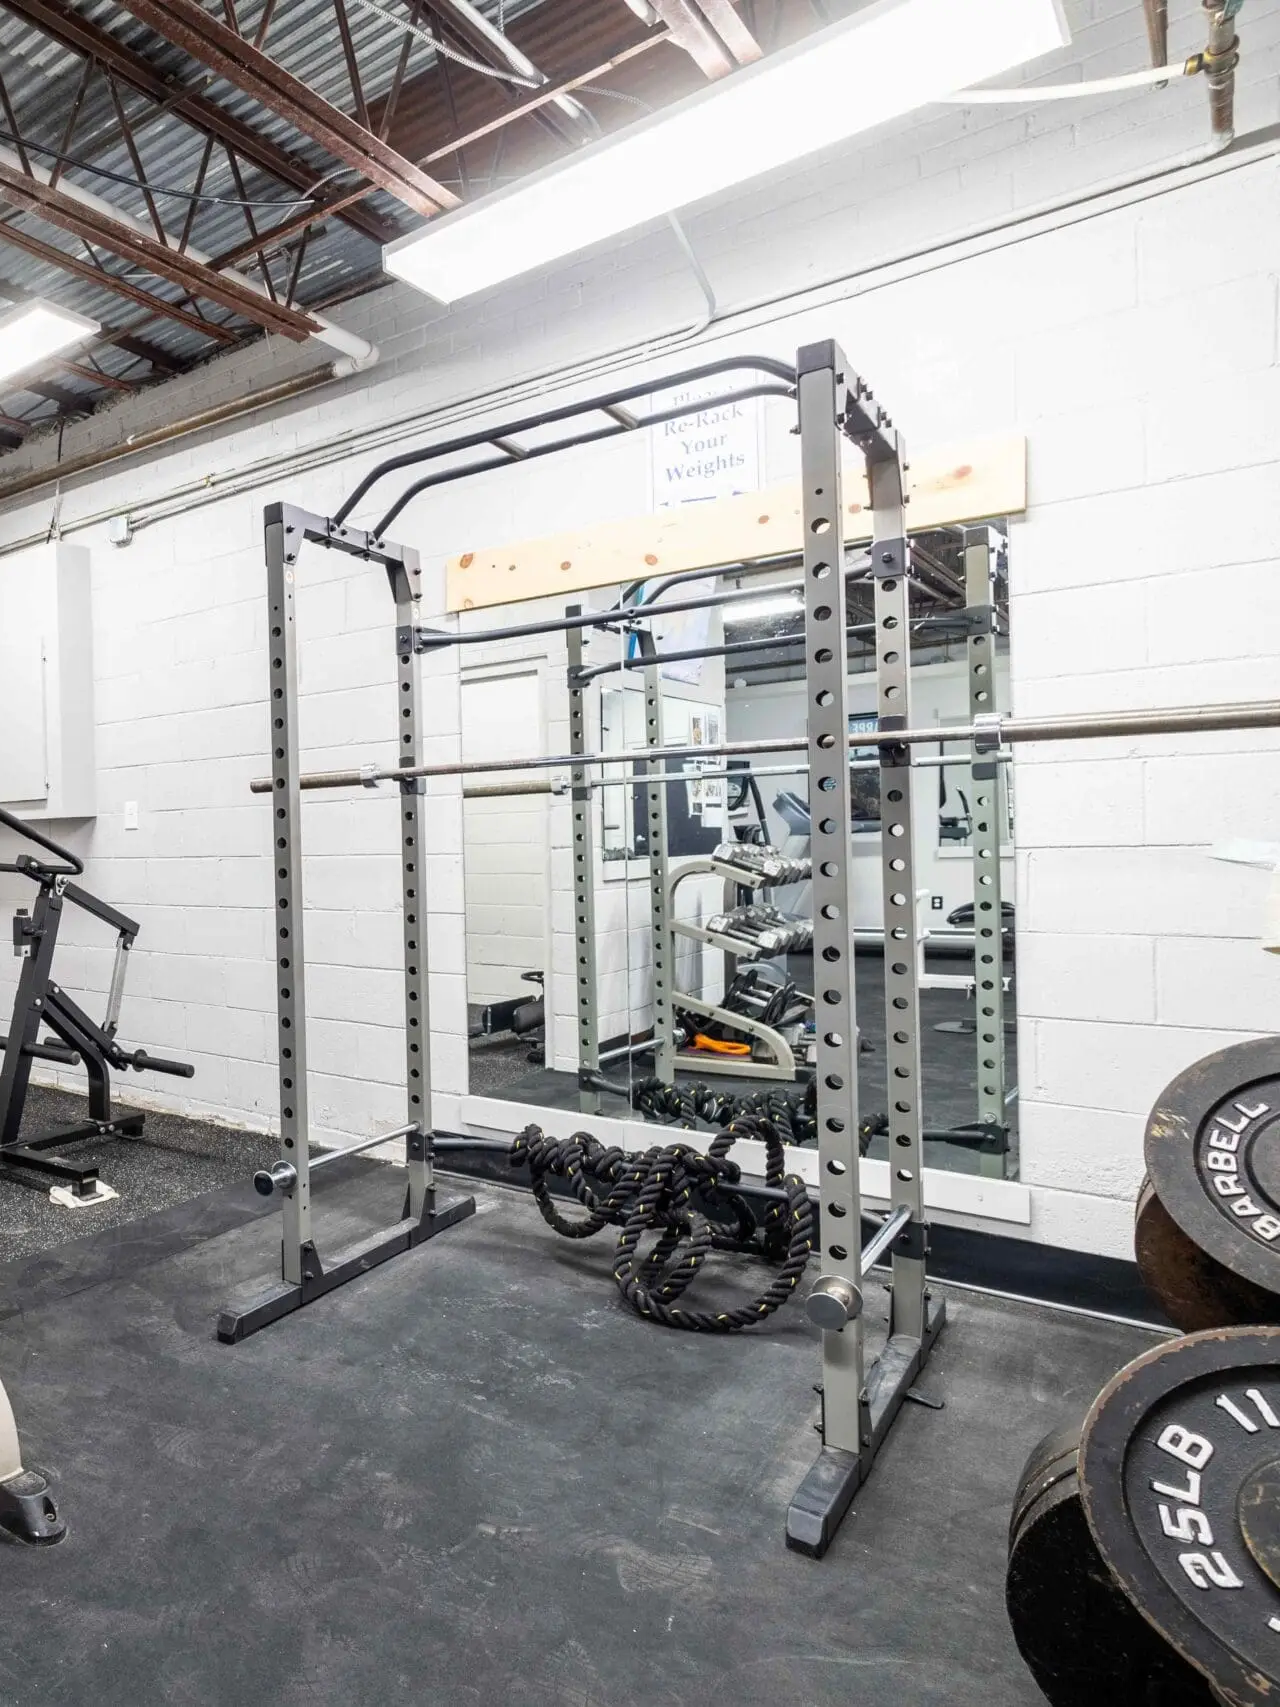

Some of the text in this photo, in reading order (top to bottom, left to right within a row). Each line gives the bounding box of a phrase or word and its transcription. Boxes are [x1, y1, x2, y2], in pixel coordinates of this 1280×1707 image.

[664, 404, 744, 436] Re-Rack
[681, 434, 728, 455] Your
[665, 453, 746, 483] Weights
[1207, 1099, 1280, 1242] BARBELL
[1150, 1423, 1244, 1590] 25LB
